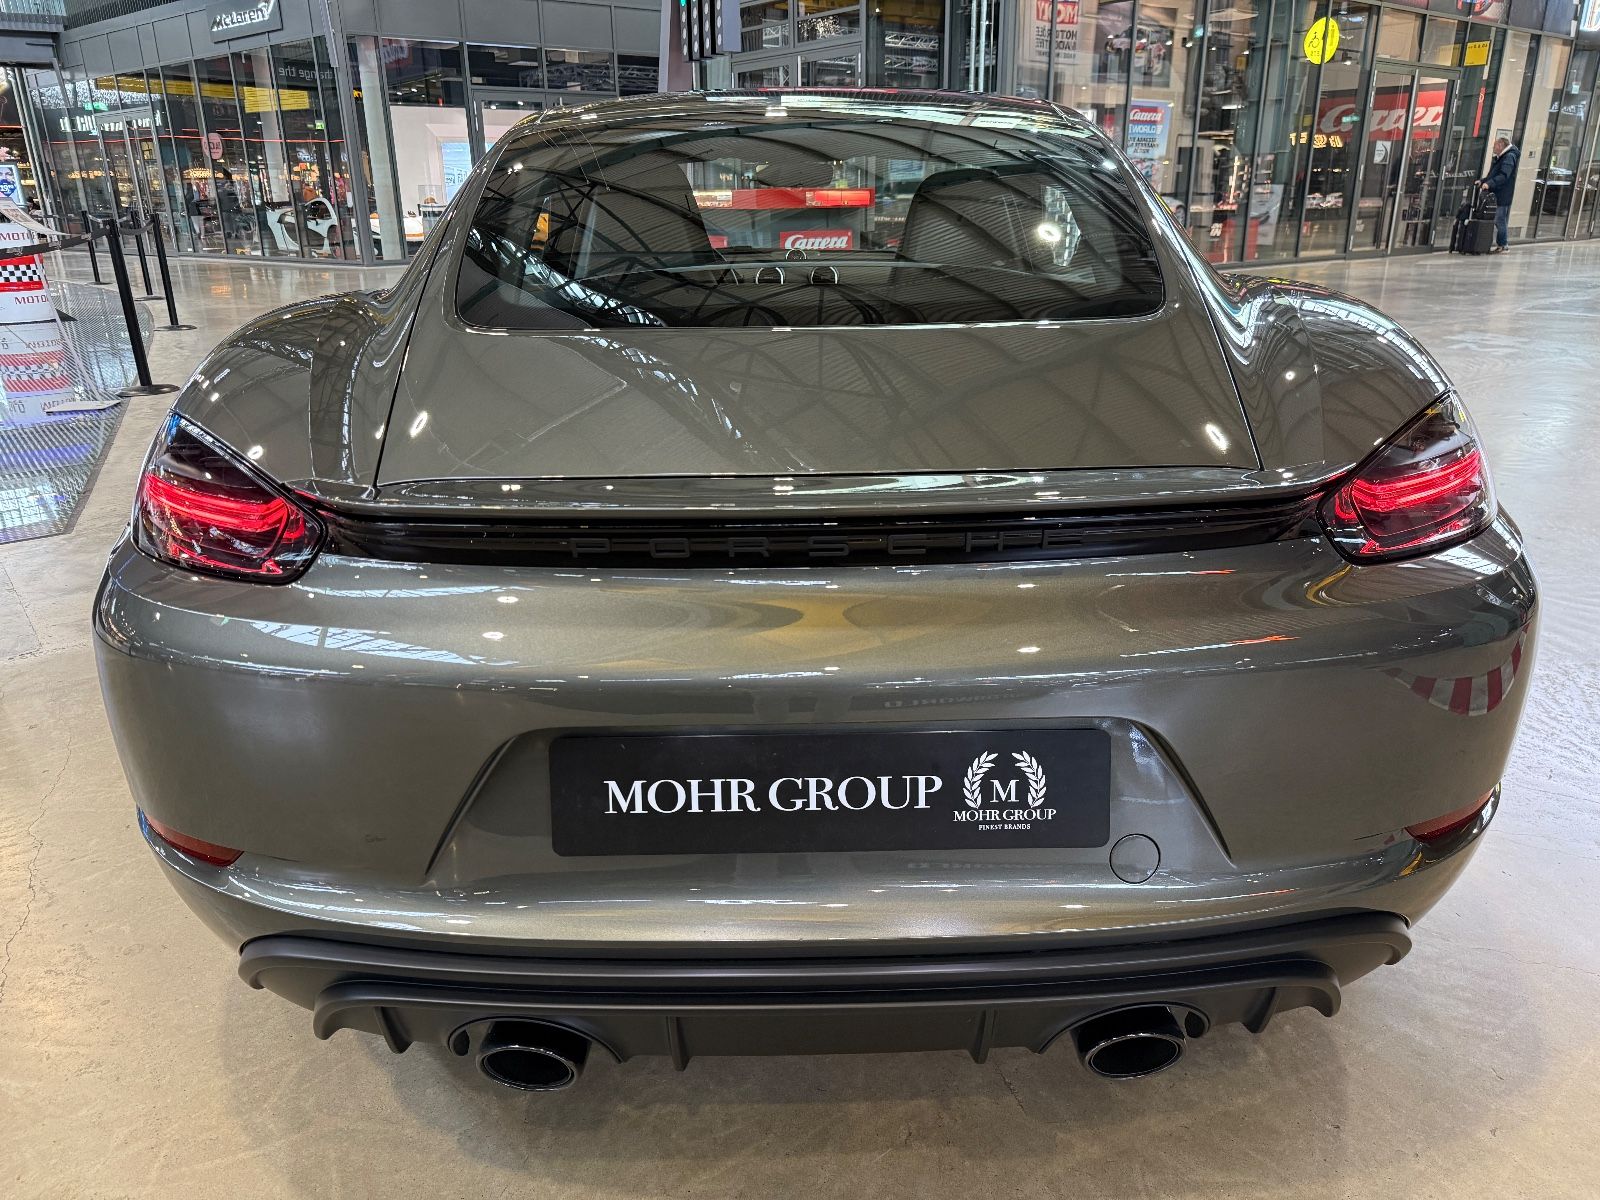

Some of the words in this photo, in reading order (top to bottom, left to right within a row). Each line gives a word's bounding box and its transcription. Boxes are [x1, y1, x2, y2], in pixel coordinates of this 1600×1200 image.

[210, 7, 267, 31] McLaren
[785, 235, 849, 250] Carrera
[570, 528, 1084, 558] PORSCHE
[604, 778, 762, 814] MOHR
[768, 775, 943, 812] GROUP
[990, 779, 1020, 803] M
[952, 809, 1002, 822] MOHR
[1002, 808, 1057, 821] GROUP
